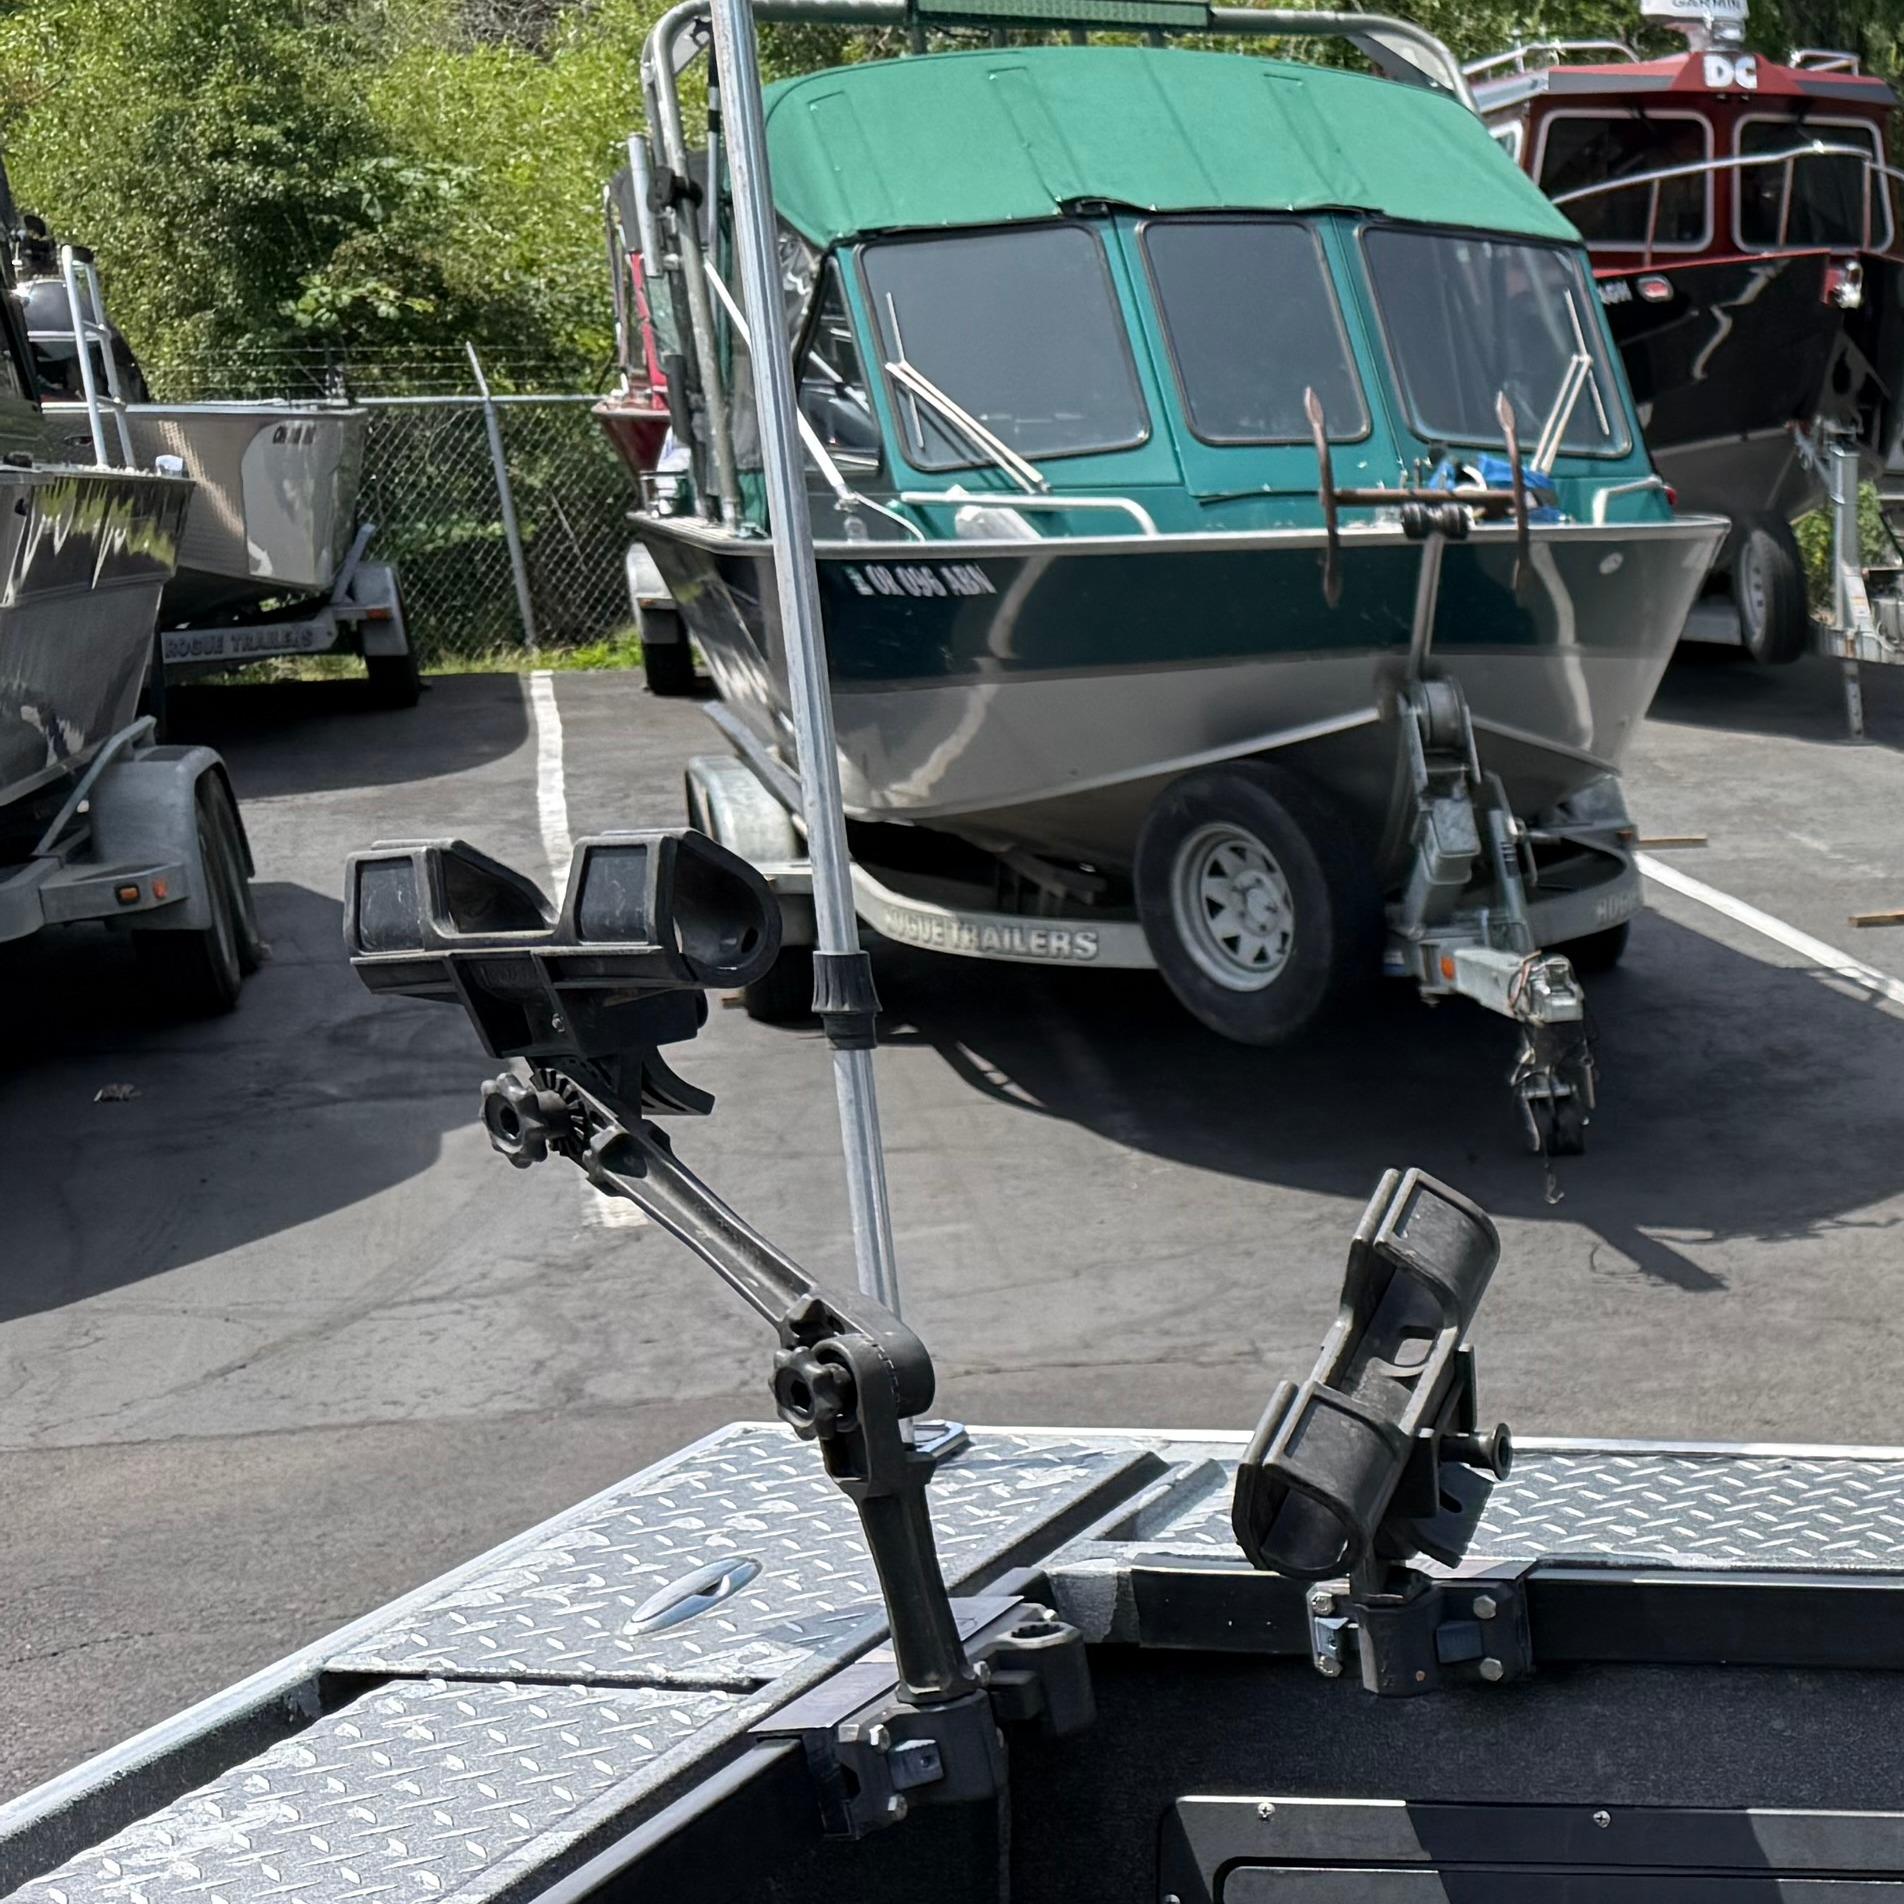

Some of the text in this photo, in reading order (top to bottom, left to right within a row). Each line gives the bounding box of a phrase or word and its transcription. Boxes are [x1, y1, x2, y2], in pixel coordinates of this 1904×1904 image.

[1704, 55, 1758, 89] DC
[865, 564, 905, 596] OR
[164, 628, 313, 659] ROGUE TRAILERS
[950, 919, 1099, 962] TRAILERS
